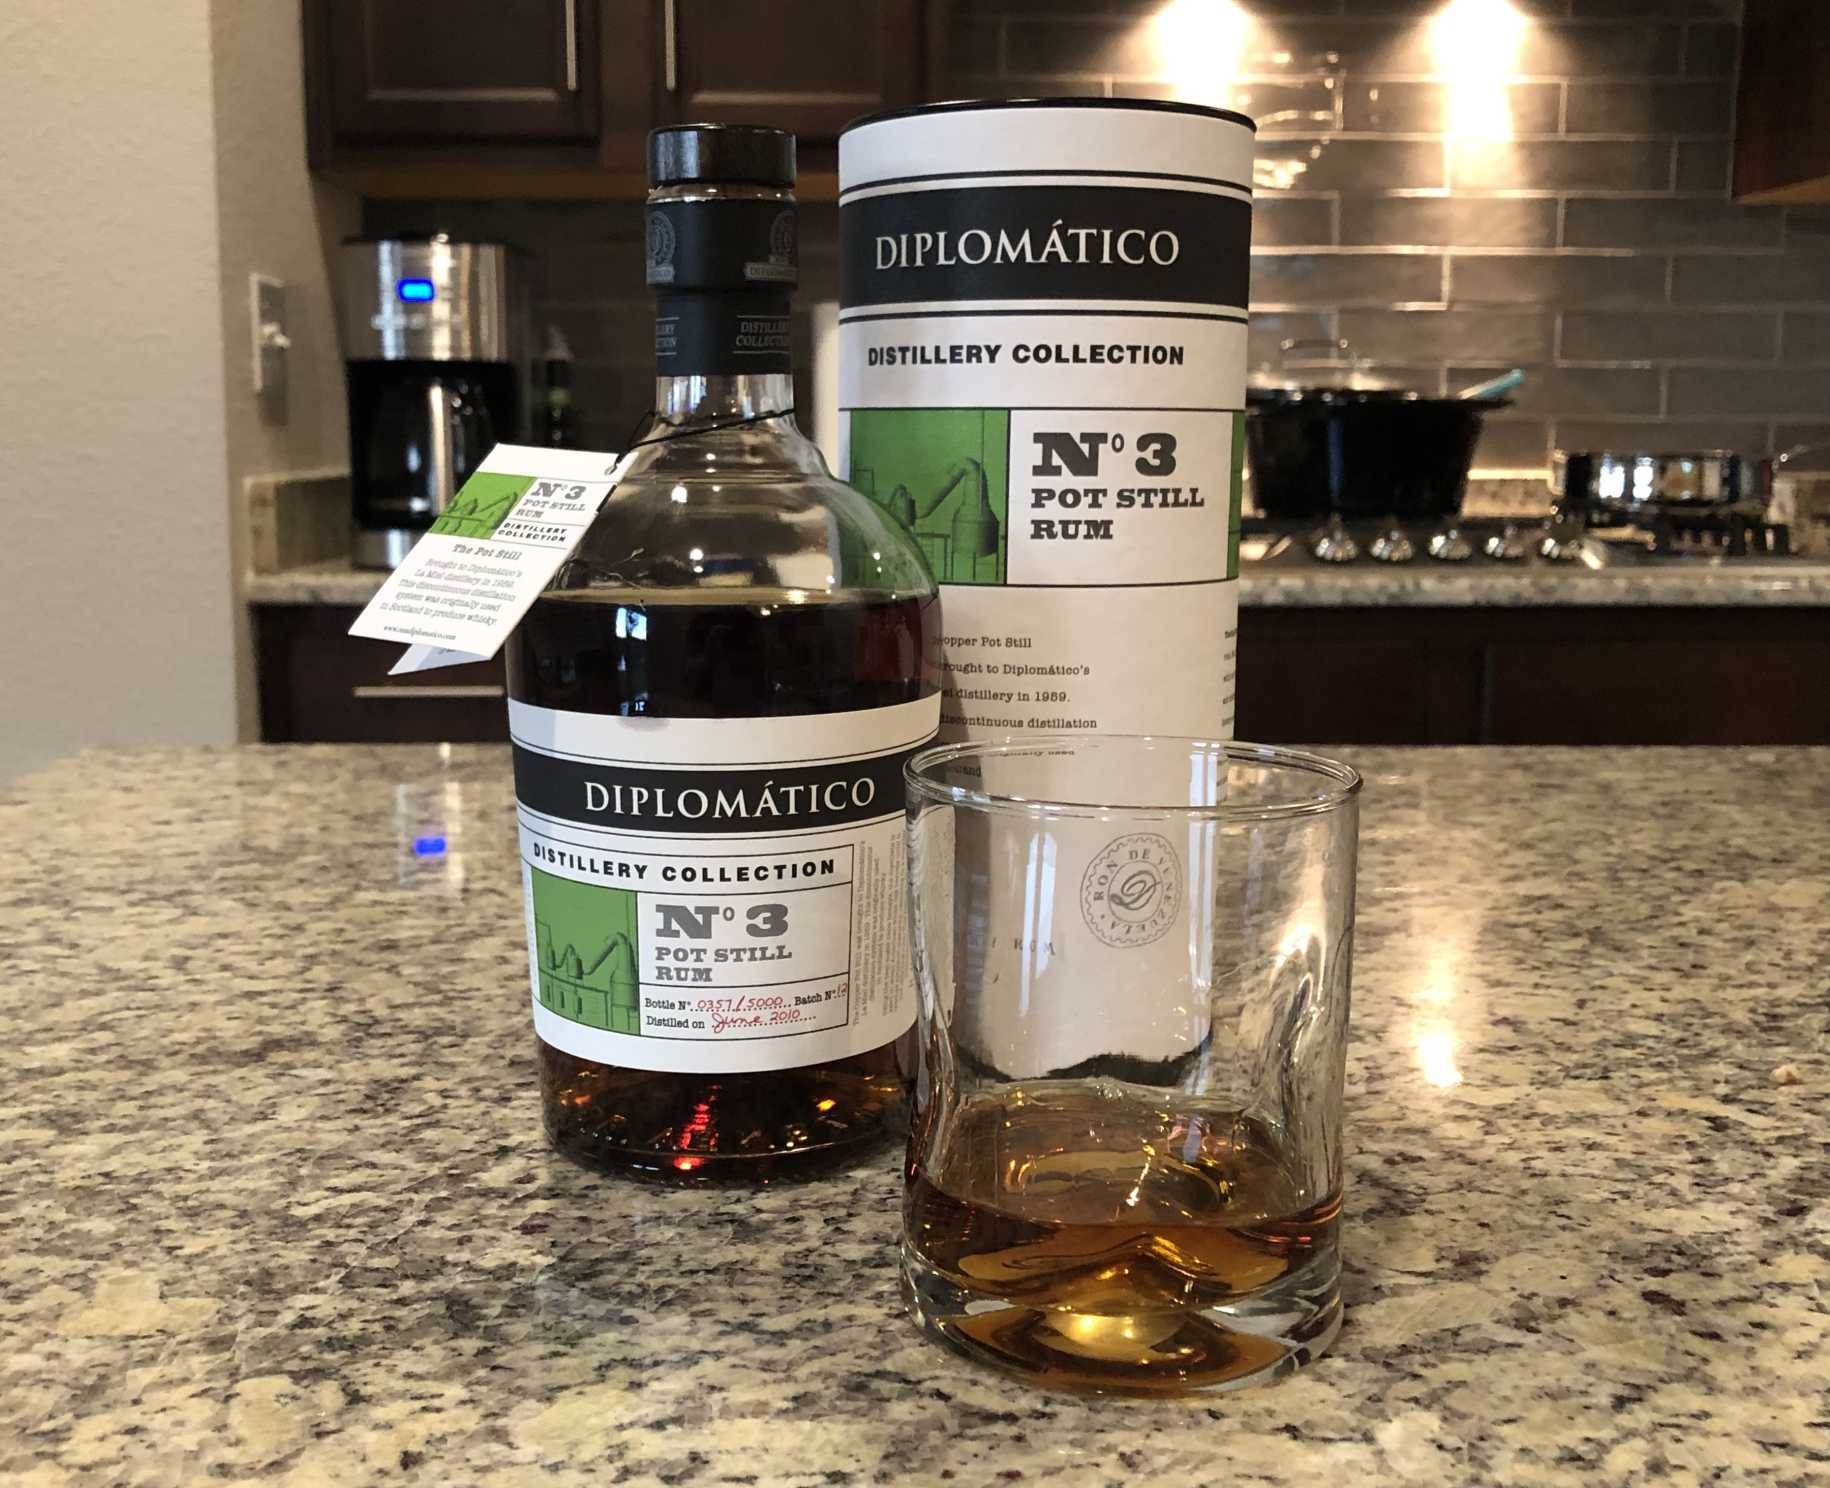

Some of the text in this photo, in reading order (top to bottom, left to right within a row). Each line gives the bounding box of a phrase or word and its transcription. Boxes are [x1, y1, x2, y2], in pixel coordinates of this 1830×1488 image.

[875, 219, 1180, 270] DIPLOMÁTICO
[868, 343, 1185, 367] DISTILLERY COLLECTION
[522, 499, 587, 512] POT STILL
[1031, 487, 1205, 509] POT STILL
[515, 508, 544, 519] RUM
[498, 529, 567, 543] COLLECTION
[503, 522, 568, 535] DISTILLERY
[1030, 519, 1114, 540] RUM
[451, 543, 523, 561] The Pot Still
[942, 636, 1032, 649] opper Pot Still
[986, 664, 999, 674] to
[1002, 663, 1091, 677] Diplomático's
[956, 690, 1014, 704] distillery
[1017, 691, 1030, 702] in
[1027, 718, 1098, 730] distillation
[584, 777, 876, 819] DIPLOMÁTICO
[533, 842, 649, 880] DISTILLERY
[661, 858, 835, 883] COLLECTION
[655, 945, 793, 963] POT STILL
[655, 965, 713, 983] RUM
[644, 997, 676, 1010] Bottle
[794, 992, 823, 1006] Batch
[646, 1009, 801, 1034] Distilled on June 2010
